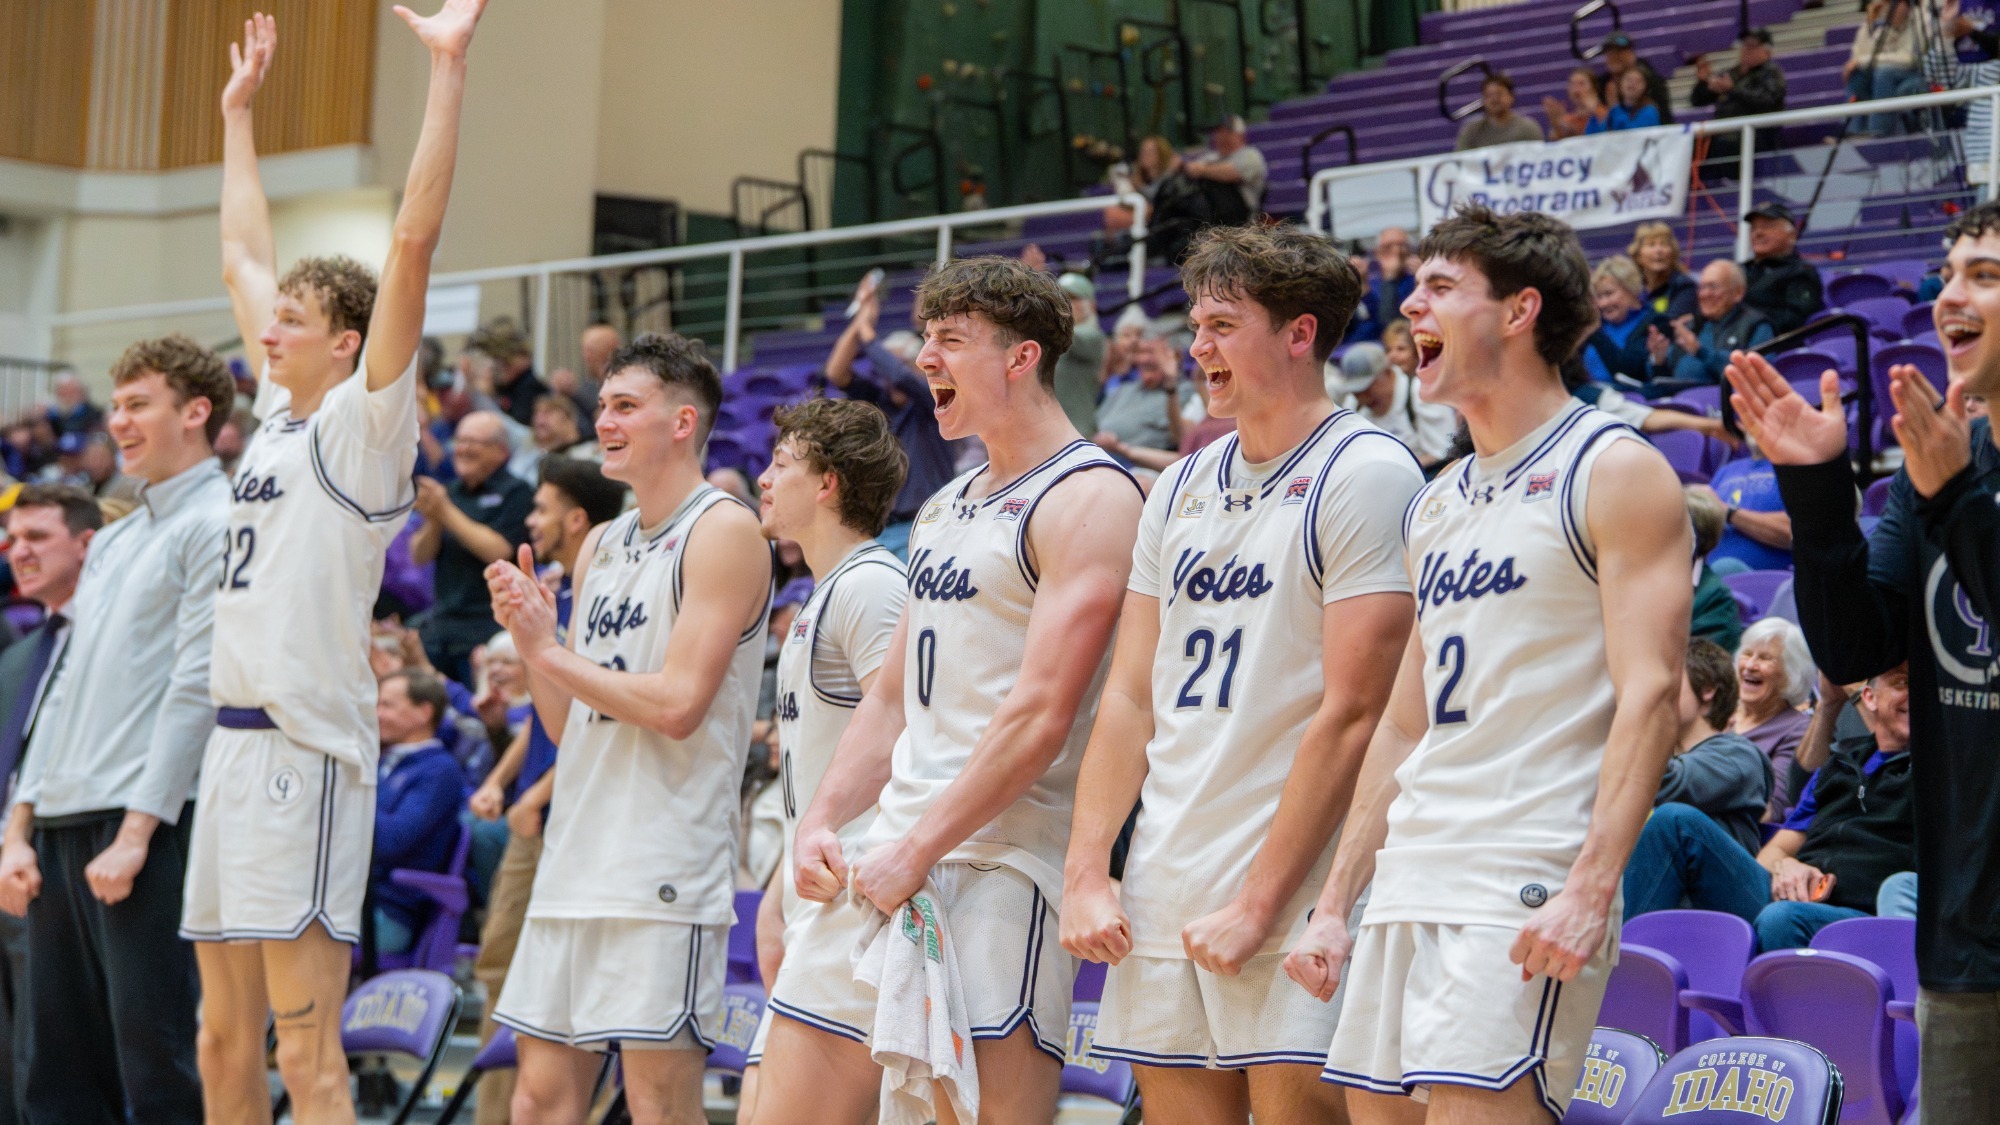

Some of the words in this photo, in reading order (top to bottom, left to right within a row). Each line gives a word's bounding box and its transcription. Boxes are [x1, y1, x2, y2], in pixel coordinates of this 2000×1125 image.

[1483, 157, 1594, 187] Legacy
[1167, 546, 1274, 608] Yotes
[1418, 549, 1527, 623] Yotes
[917, 627, 937, 708] 0
[1175, 625, 1245, 711] 21
[1436, 634, 1469, 726] 2
[1662, 1066, 1795, 1123] IDAHO
[1698, 1052, 1767, 1067] COLLEGE
[1772, 1060, 1786, 1072] OF
